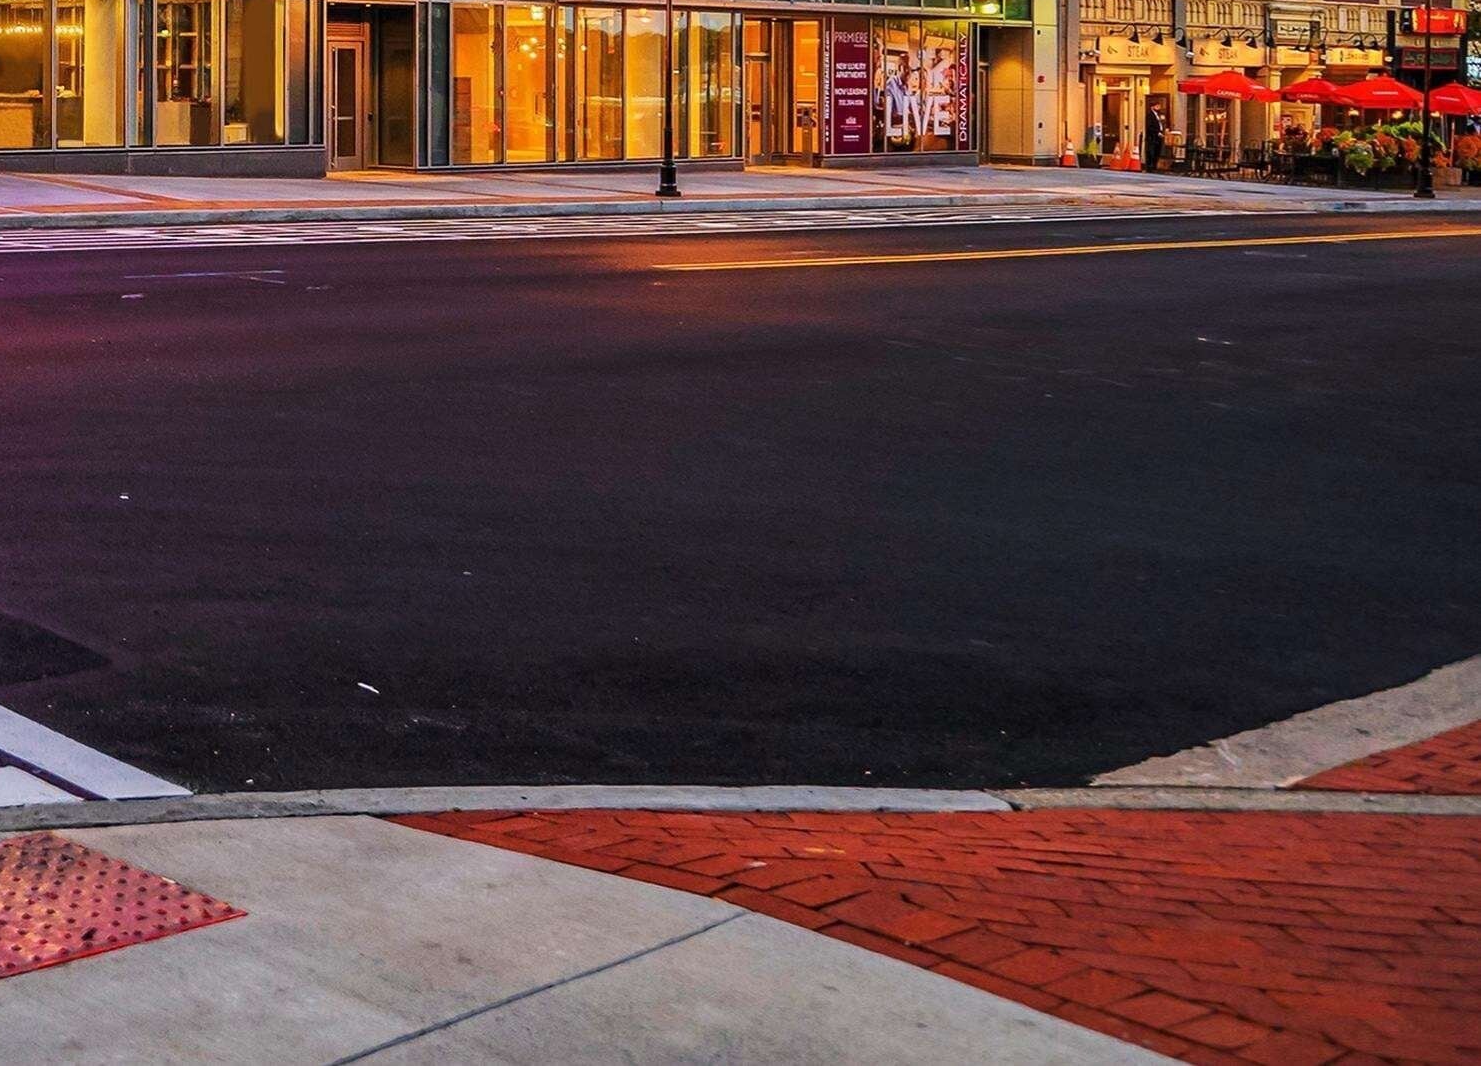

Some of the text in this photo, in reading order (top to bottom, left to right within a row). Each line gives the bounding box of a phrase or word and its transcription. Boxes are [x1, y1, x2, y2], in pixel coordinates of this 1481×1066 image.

[835, 31, 868, 43] PREMIERE
[1127, 46, 1149, 57] STEAK
[959, 32, 967, 141] DRAMATICALLY
[886, 95, 950, 136] LIVE
